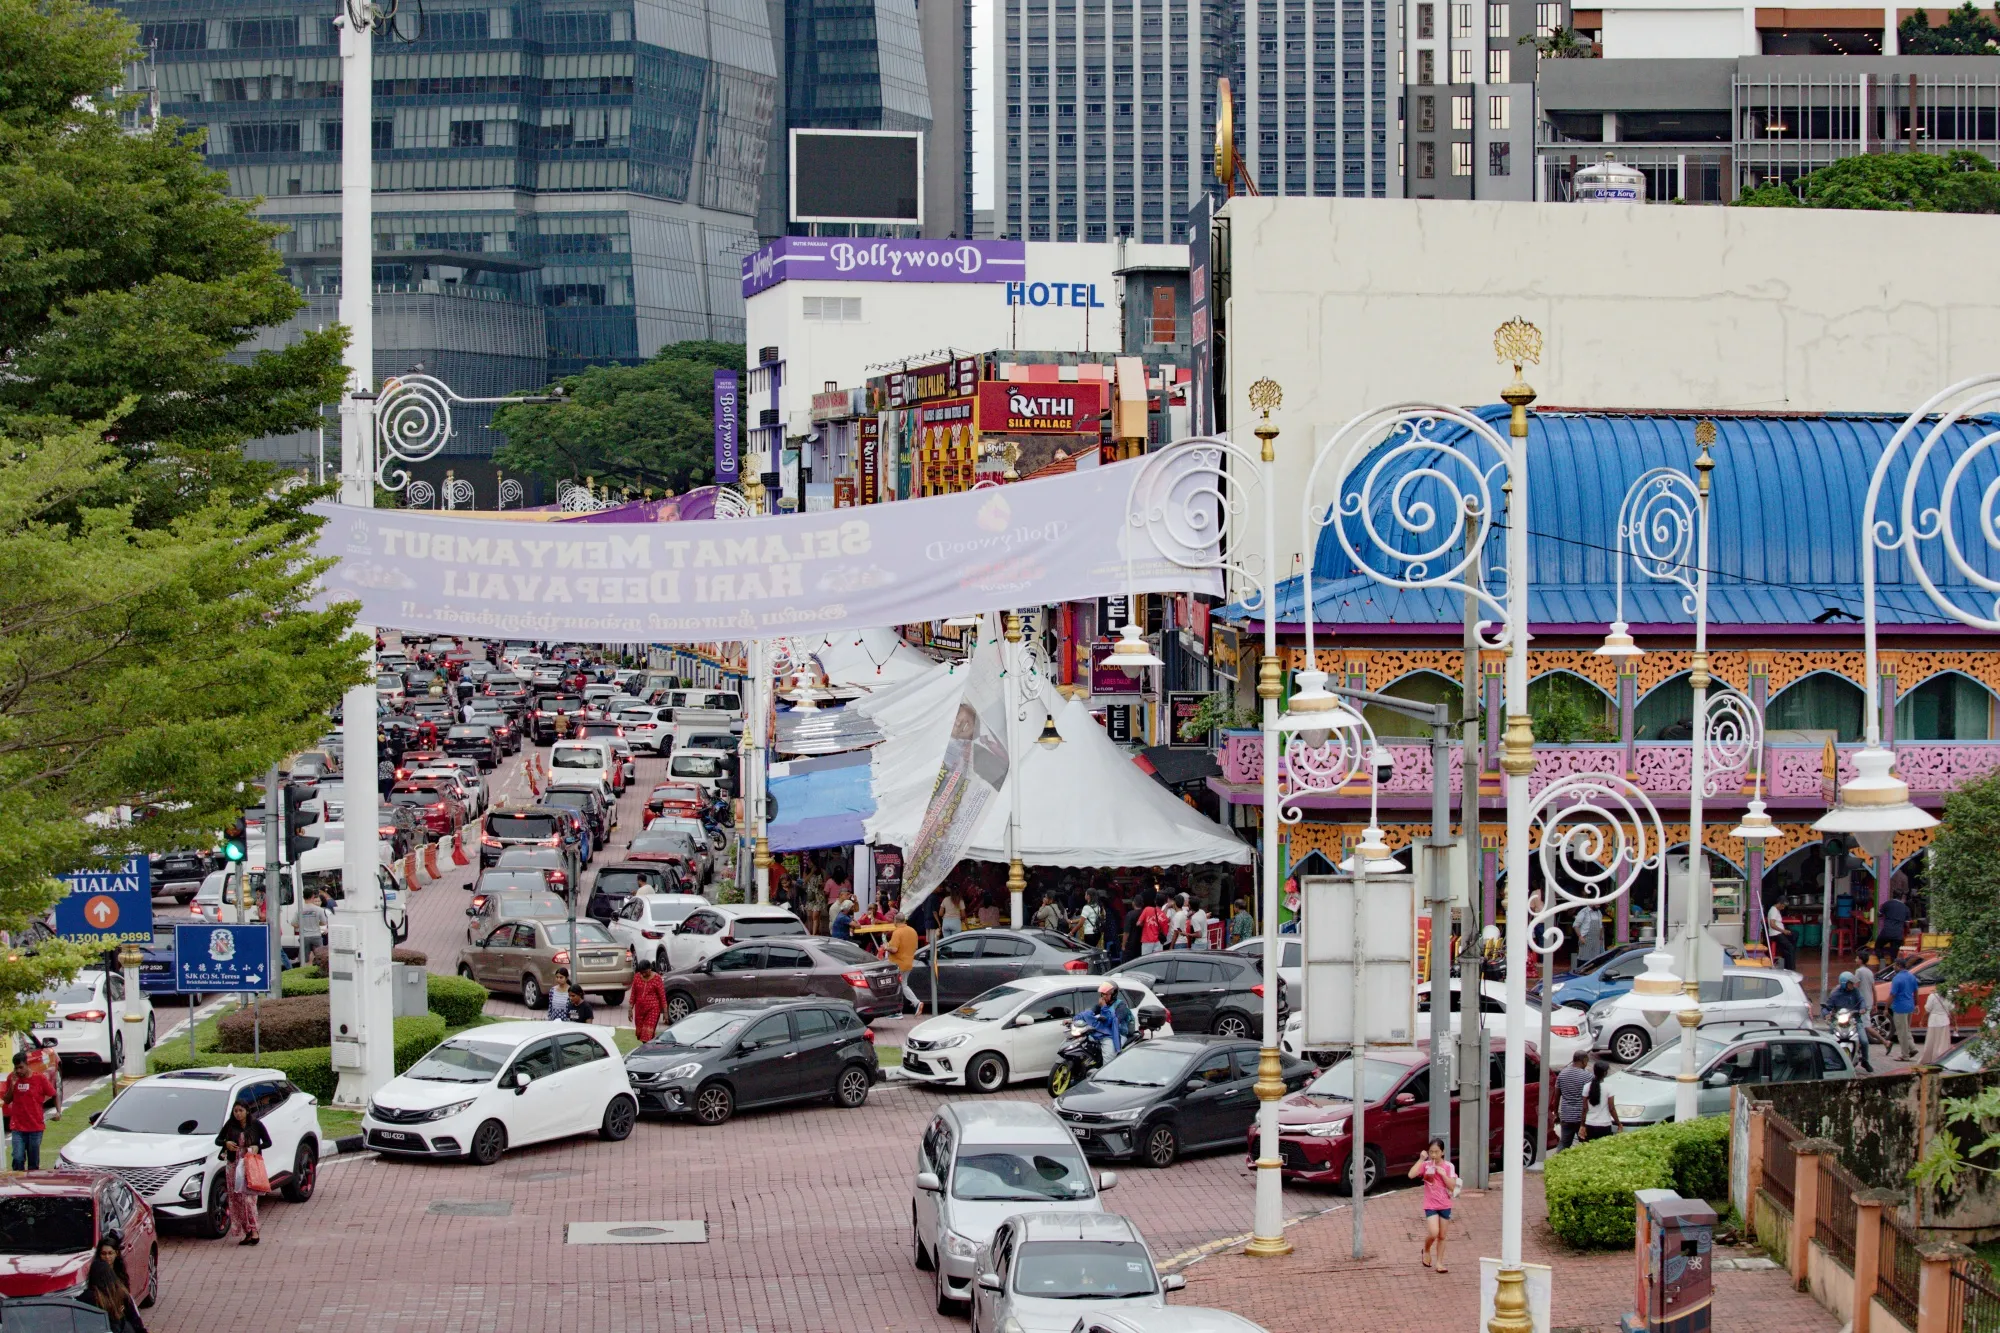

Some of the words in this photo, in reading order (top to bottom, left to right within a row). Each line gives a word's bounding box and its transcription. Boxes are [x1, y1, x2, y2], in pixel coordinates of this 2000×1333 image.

[1617, 190, 1635, 198] Kong
[1006, 281, 1105, 308] HOTEL
[902, 373, 918, 405] RATHI
[918, 376, 928, 399] SILK
[928, 373, 946, 397] PALACE
[1010, 394, 1074, 418] RATHI
[1008, 418, 1033, 428] SILK
[1033, 418, 1072, 429] PALACE
[863, 440, 876, 474] RATHI
[865, 475, 873, 496] SILK
[69, 933, 99, 943] 1300
[121, 931, 151, 942] 9898
